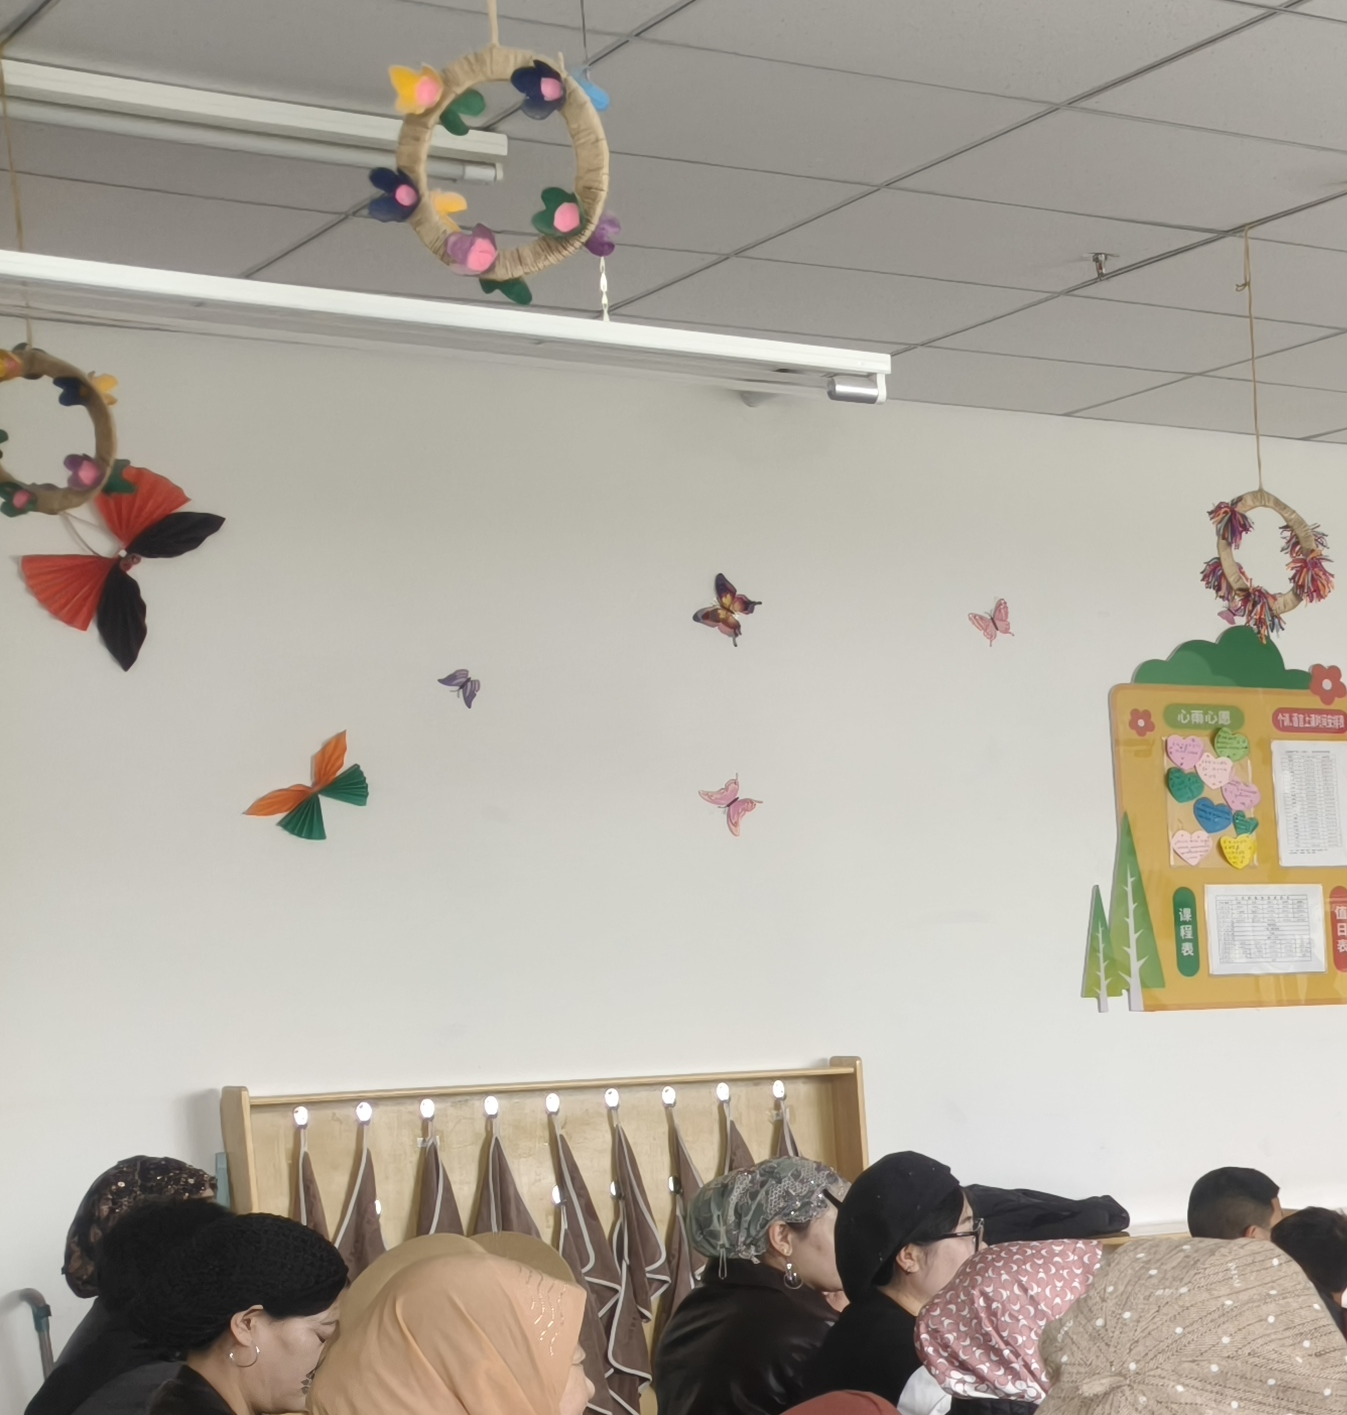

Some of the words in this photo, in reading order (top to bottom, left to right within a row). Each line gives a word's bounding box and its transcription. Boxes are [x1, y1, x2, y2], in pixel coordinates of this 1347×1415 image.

[1177, 709, 1231, 725] 心雨心愿
[1178, 907, 1195, 957] 课程表
